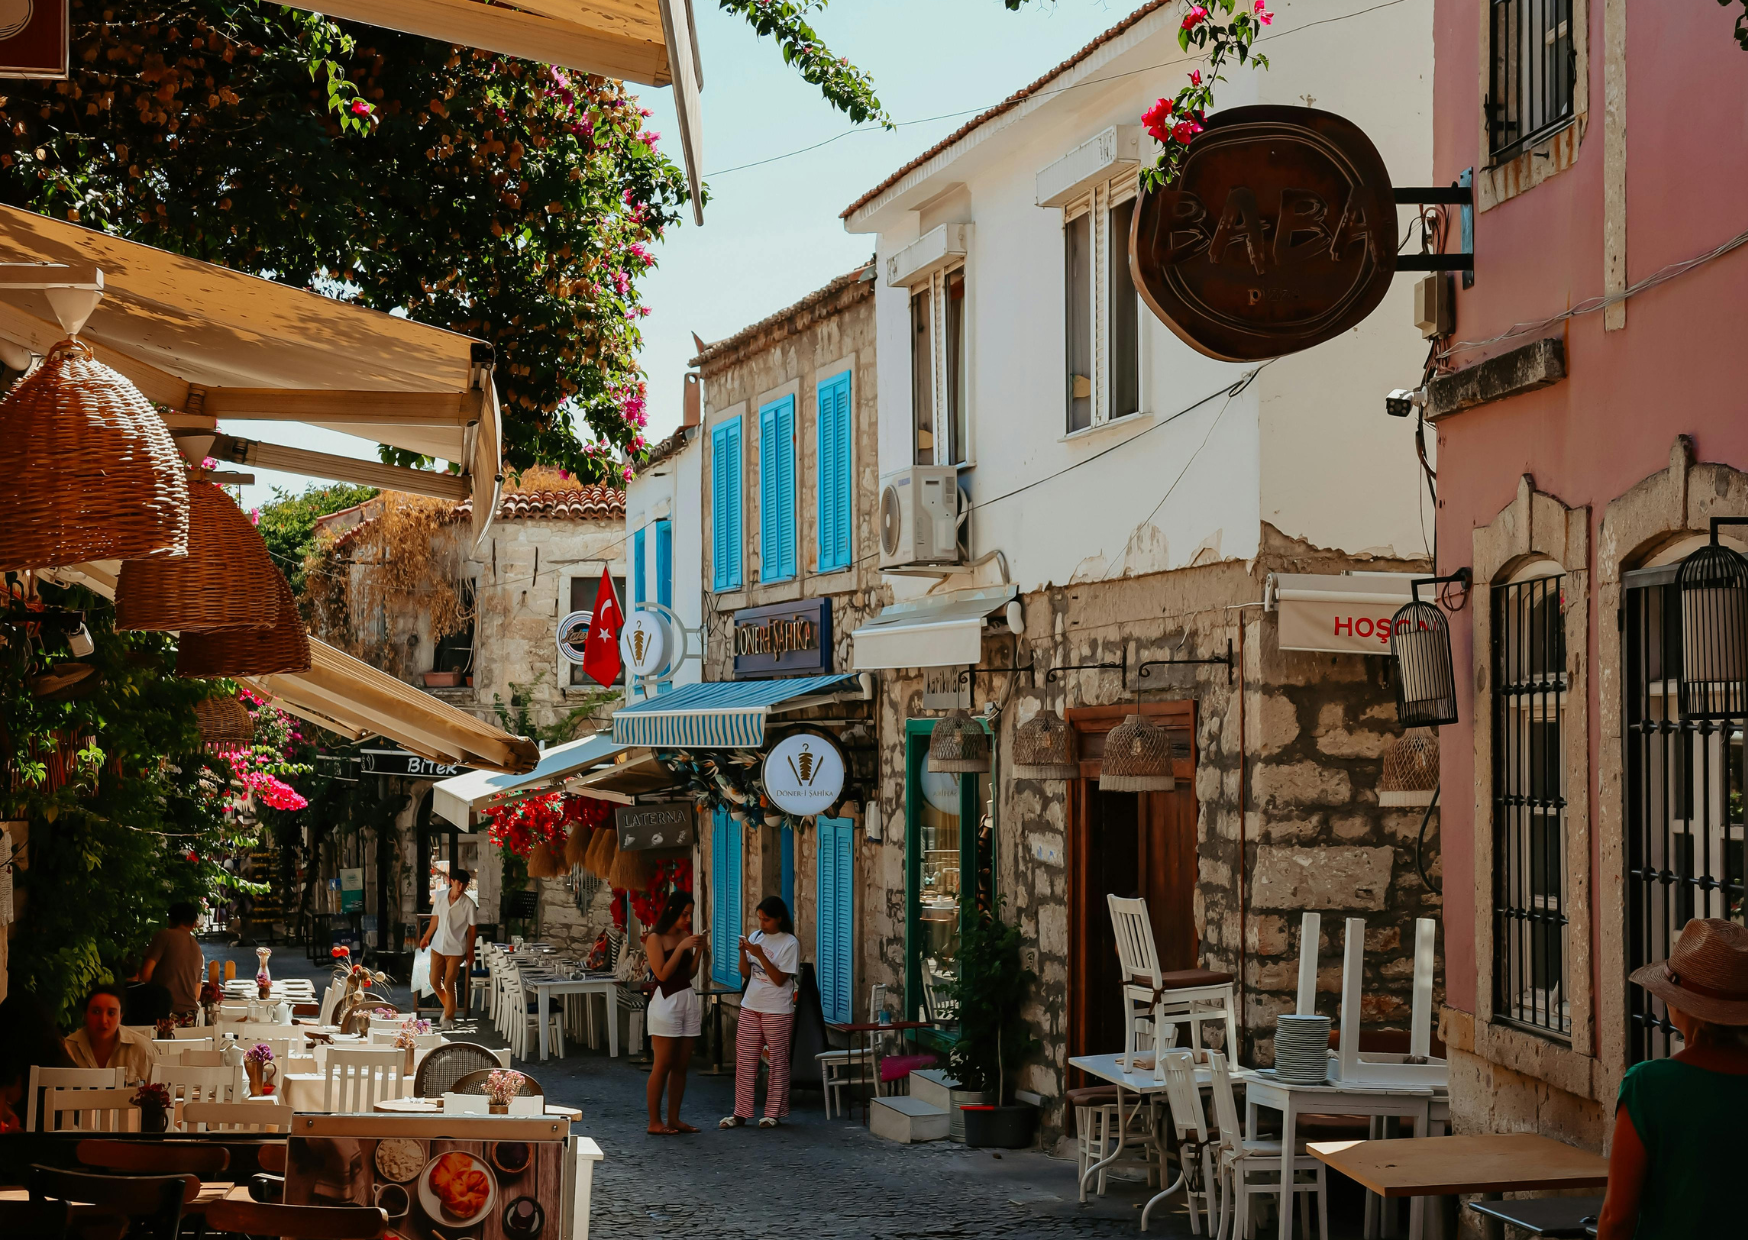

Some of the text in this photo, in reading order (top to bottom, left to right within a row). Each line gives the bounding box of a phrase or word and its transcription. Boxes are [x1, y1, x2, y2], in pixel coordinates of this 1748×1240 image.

[1152, 186, 1388, 275] BABA
[809, 789, 834, 798] ŞAHİKA
[623, 809, 687, 828] LATERNA
